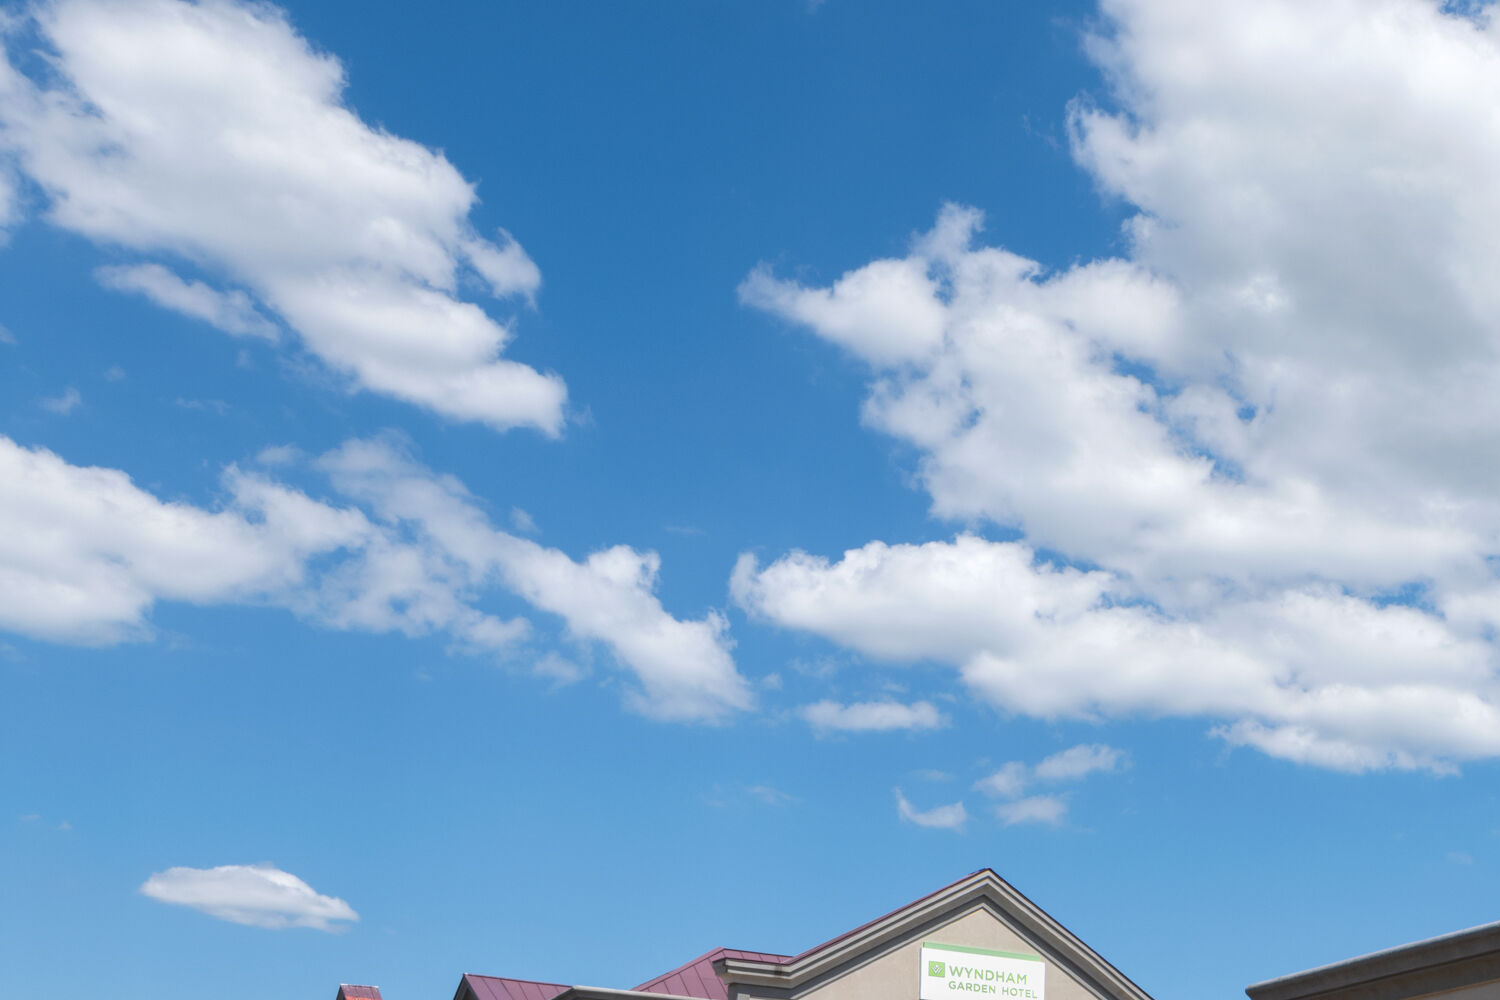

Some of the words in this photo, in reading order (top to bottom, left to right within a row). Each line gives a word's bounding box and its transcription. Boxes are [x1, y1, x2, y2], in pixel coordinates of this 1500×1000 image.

[949, 965, 1027, 985] WYNDHAM
[948, 980, 996, 994] GARDEN
[1002, 986, 1038, 999] HOTEL
